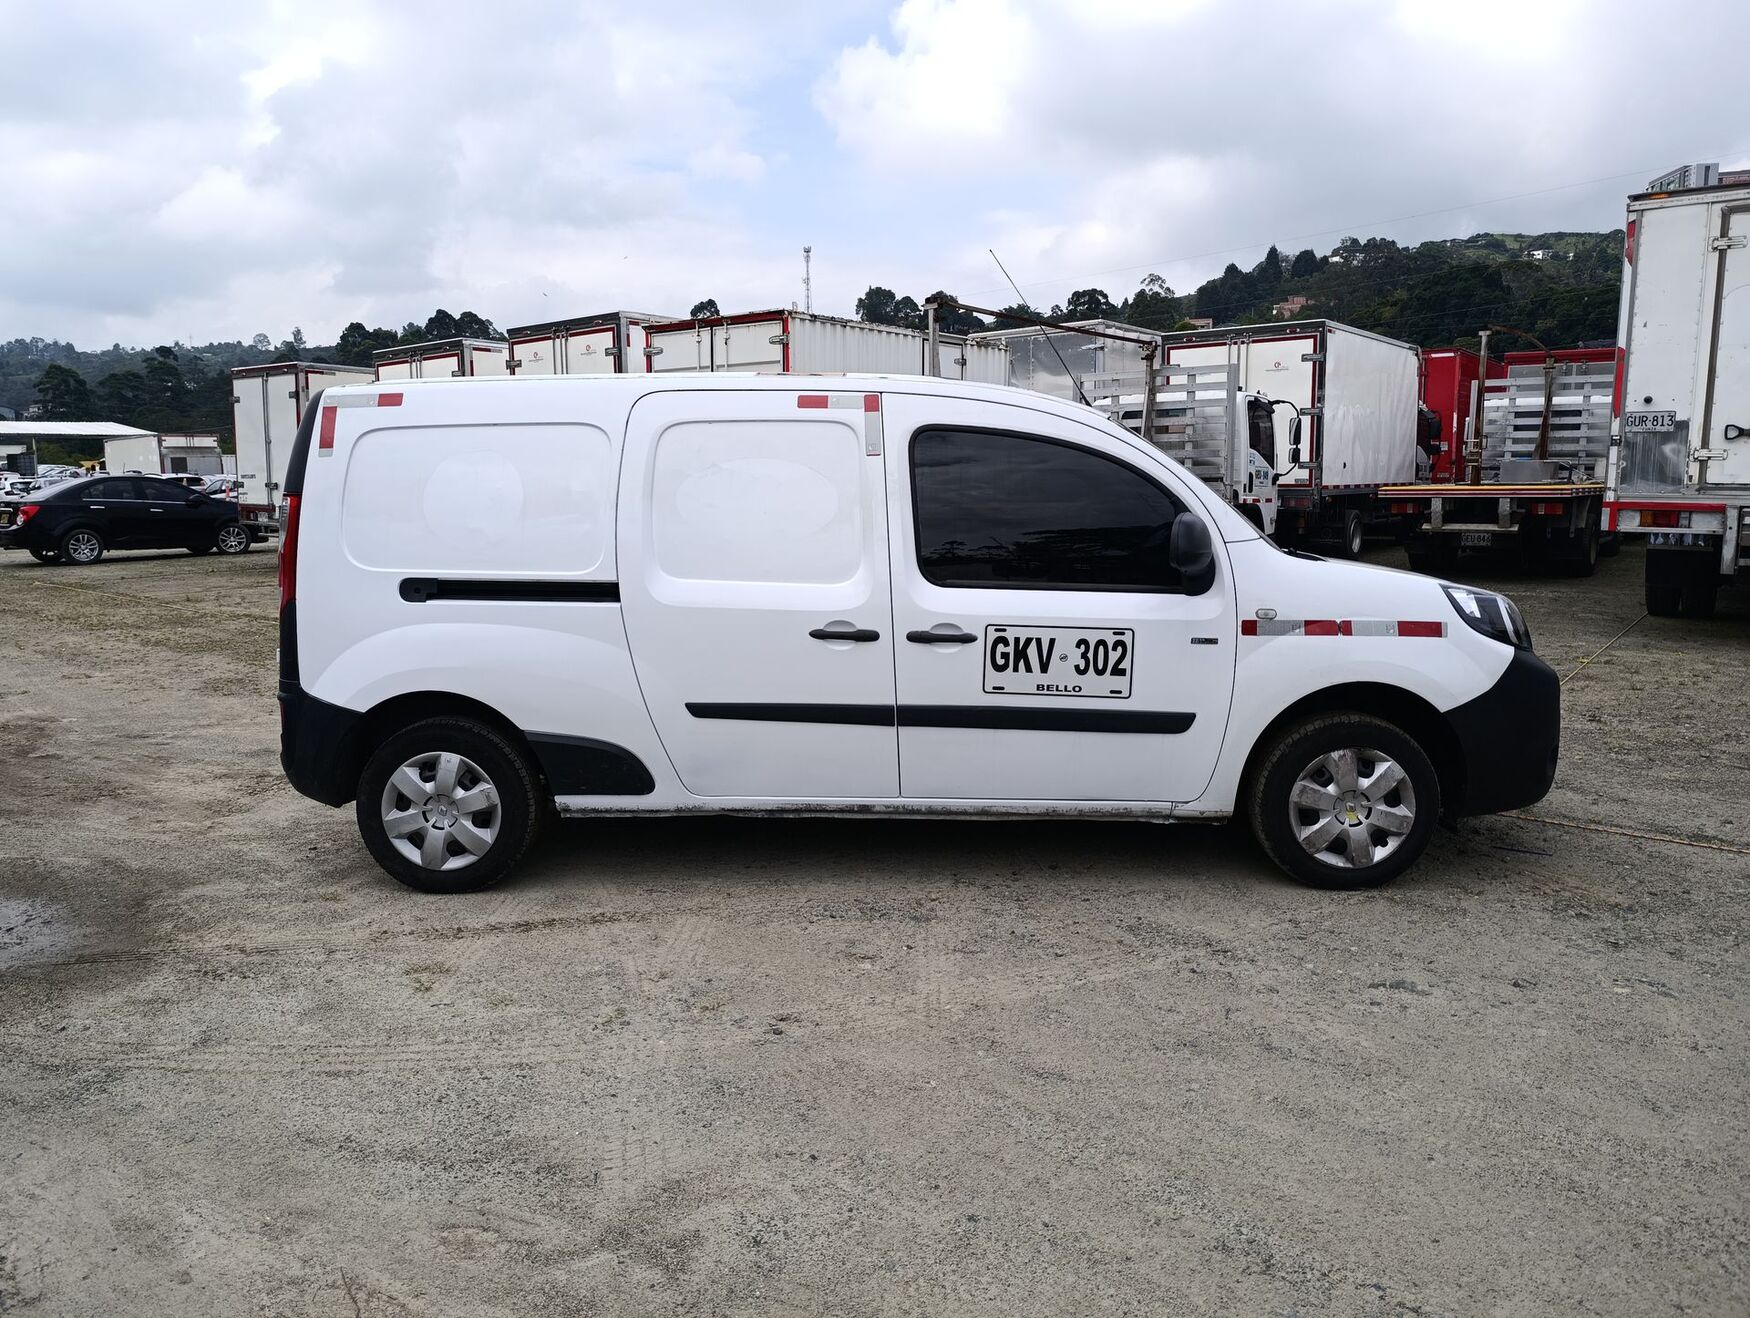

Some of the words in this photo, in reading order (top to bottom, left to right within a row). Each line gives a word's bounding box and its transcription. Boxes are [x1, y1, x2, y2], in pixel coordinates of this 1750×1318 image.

[990, 635, 1056, 674] GKV
[1073, 638, 1128, 677] 302
[1036, 684, 1082, 693] BELLO
